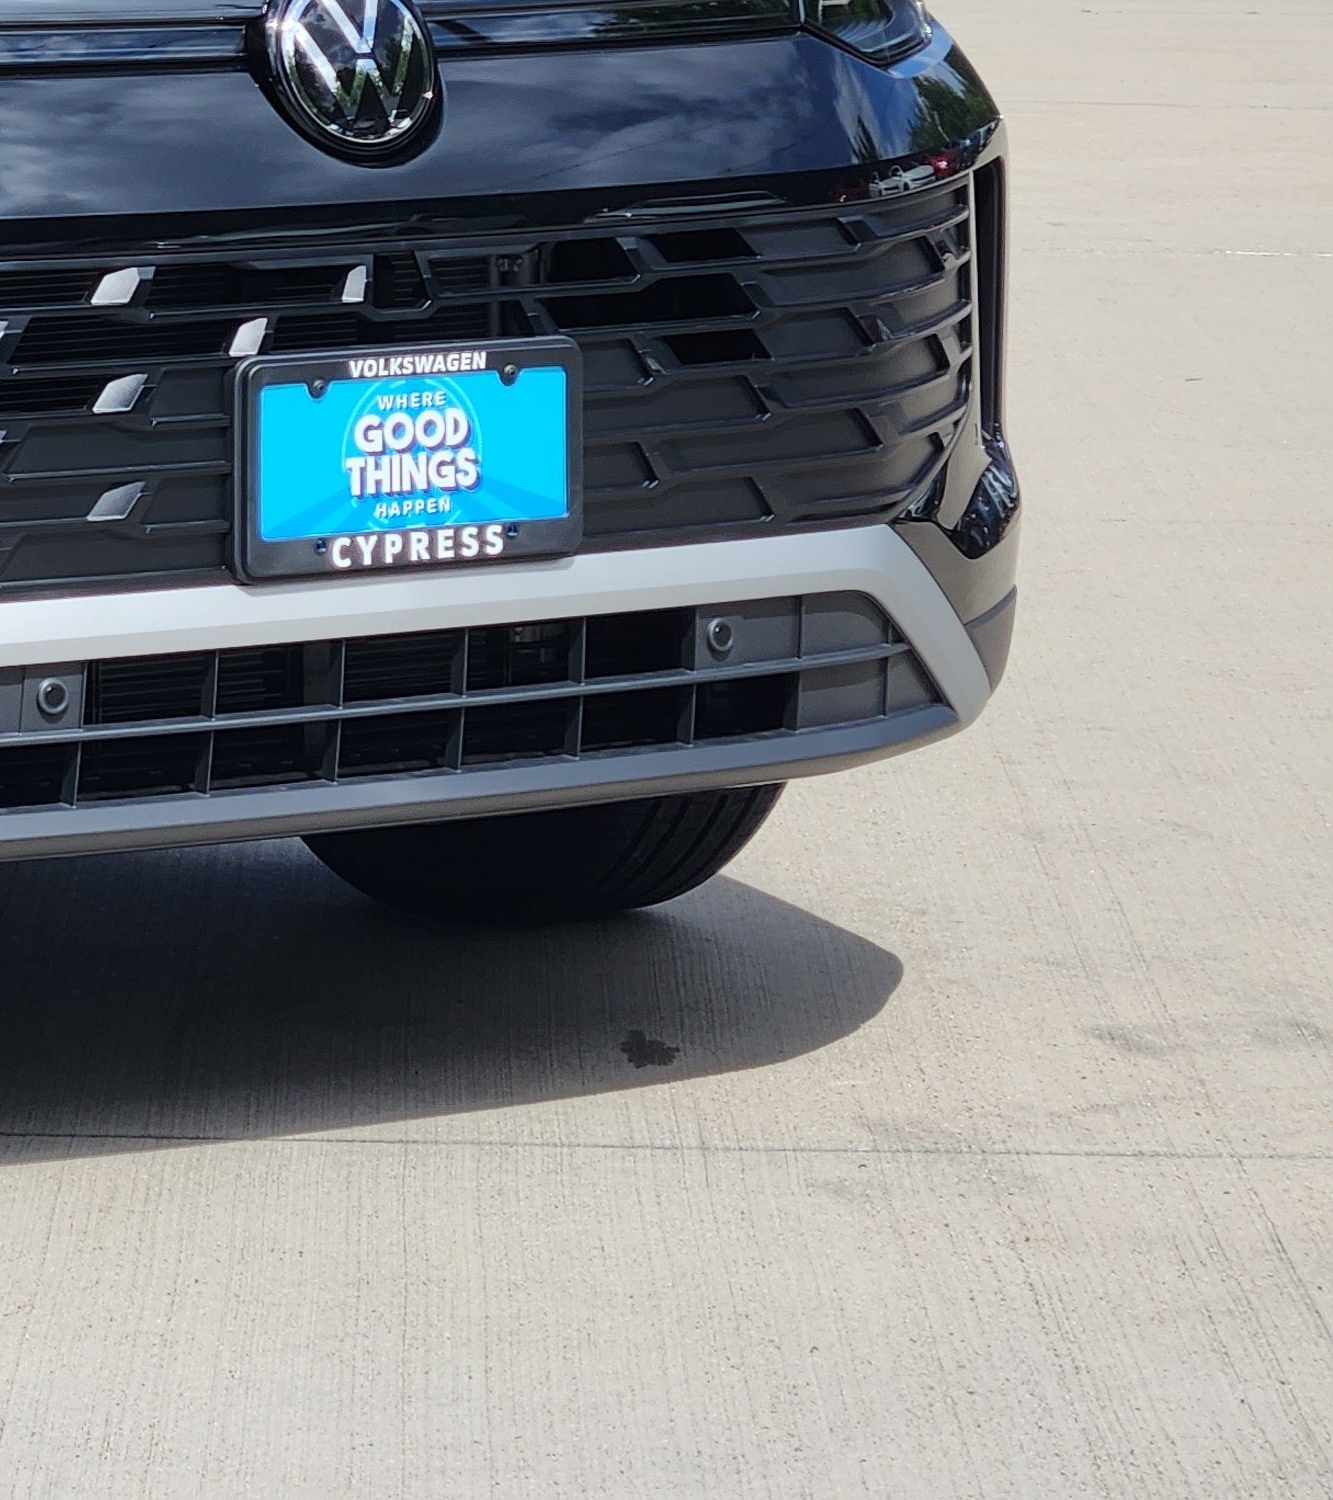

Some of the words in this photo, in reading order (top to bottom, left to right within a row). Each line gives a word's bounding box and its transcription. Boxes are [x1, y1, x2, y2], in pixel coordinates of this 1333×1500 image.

[348, 351, 487, 379] VOLKSWAGEN
[376, 390, 447, 411] WHERE
[353, 407, 470, 455] GOOD
[345, 448, 481, 500] THINGS
[374, 496, 452, 518] HAPPEN
[332, 524, 504, 569] CYPRESS
